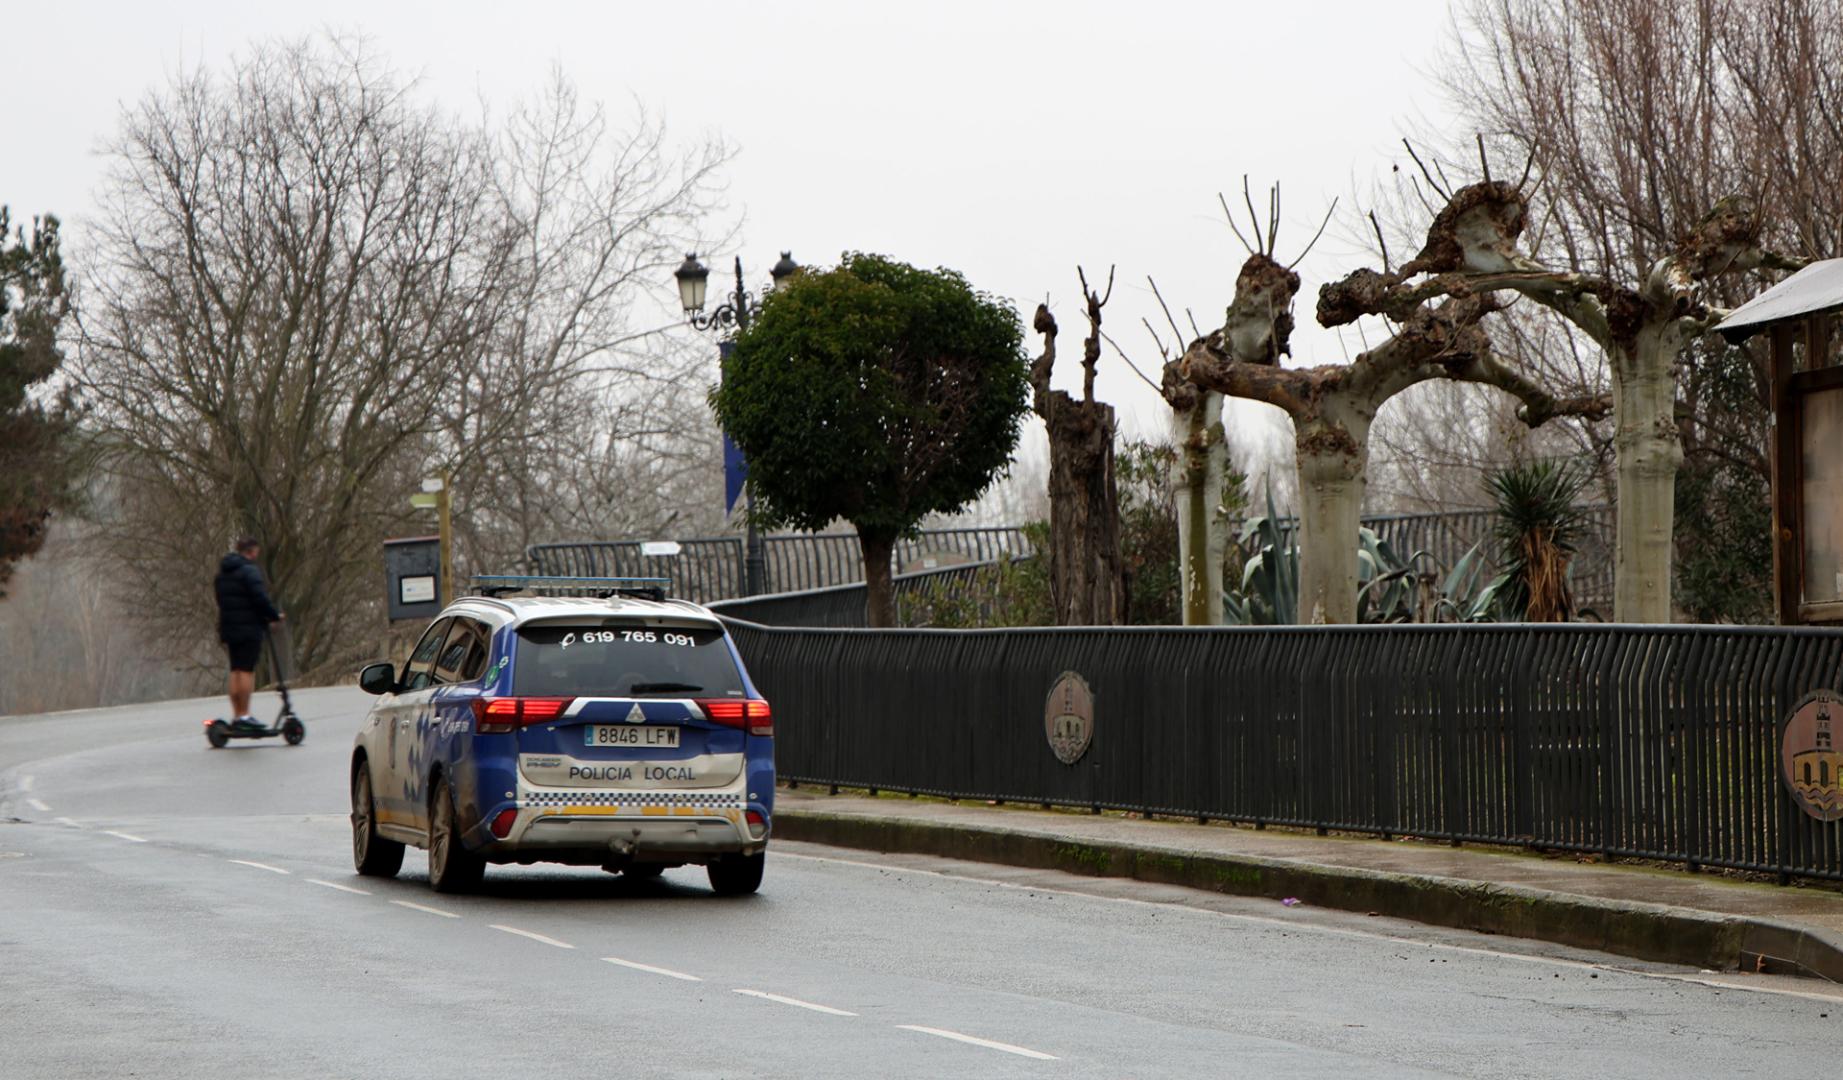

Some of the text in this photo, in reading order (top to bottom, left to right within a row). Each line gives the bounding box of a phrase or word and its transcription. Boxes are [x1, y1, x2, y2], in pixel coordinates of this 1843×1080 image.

[582, 631, 696, 648] 619 765 091
[599, 728, 638, 744] 8846
[646, 728, 676, 745] LFW
[569, 766, 697, 781] POLICIA LOCAL
